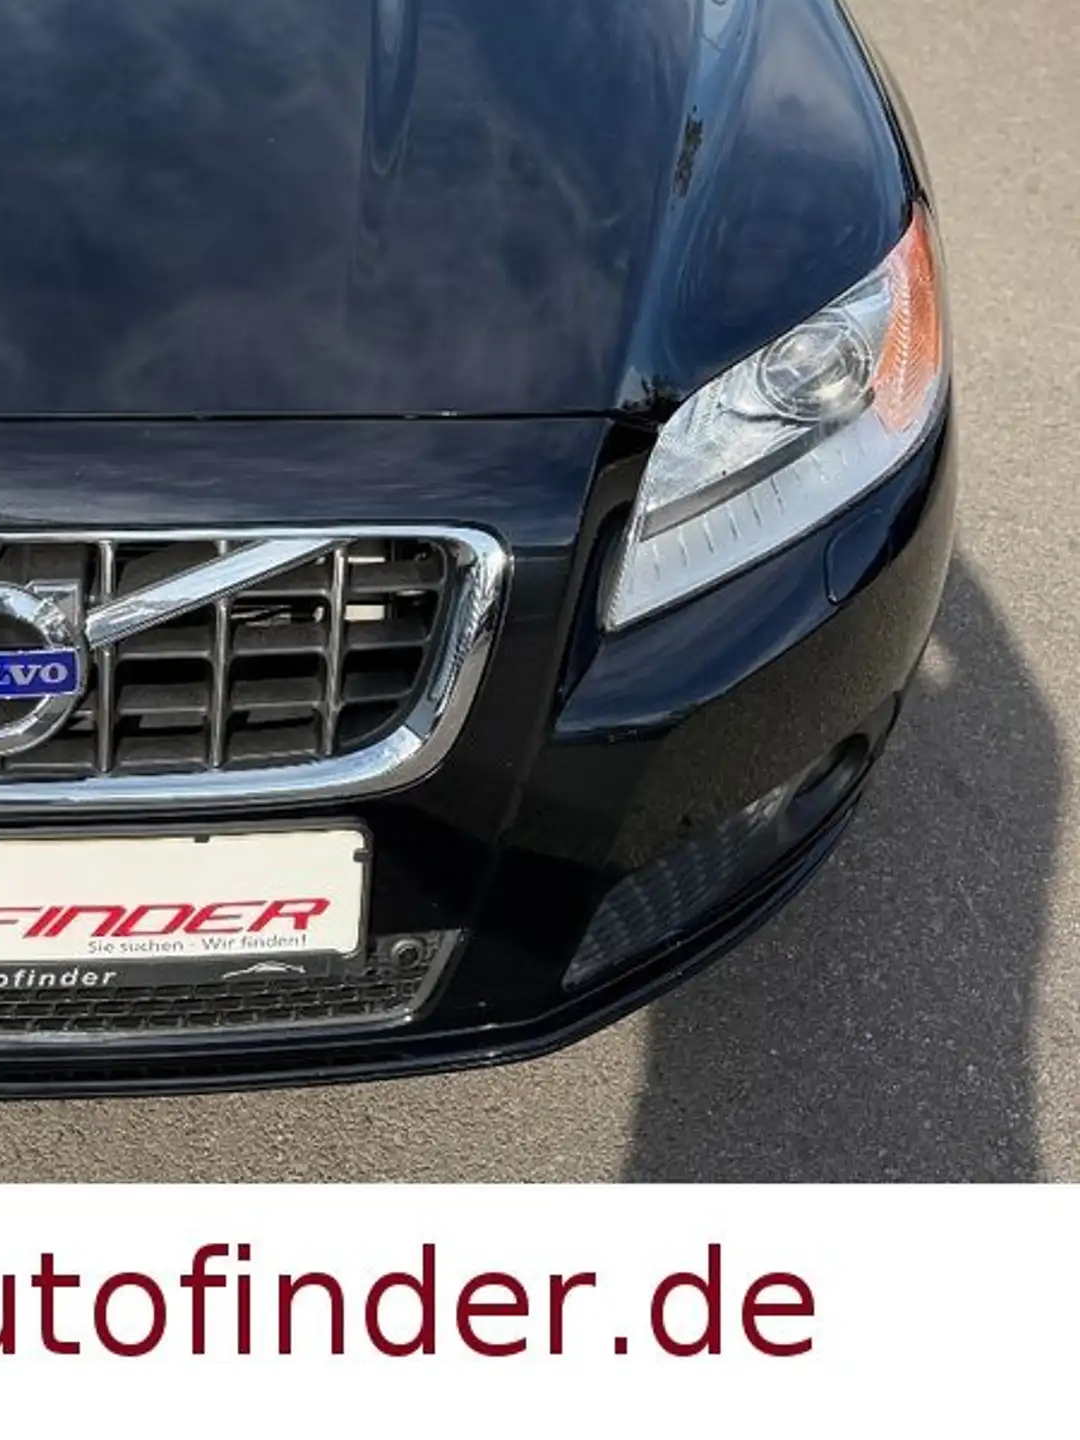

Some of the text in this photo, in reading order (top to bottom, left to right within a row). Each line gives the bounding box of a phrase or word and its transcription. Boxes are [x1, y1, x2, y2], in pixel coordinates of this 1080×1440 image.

[87, 940, 115, 955] Sie
[120, 938, 185, 954] suchen
[201, 936, 234, 952] Wir
[240, 933, 308, 950] finden!
